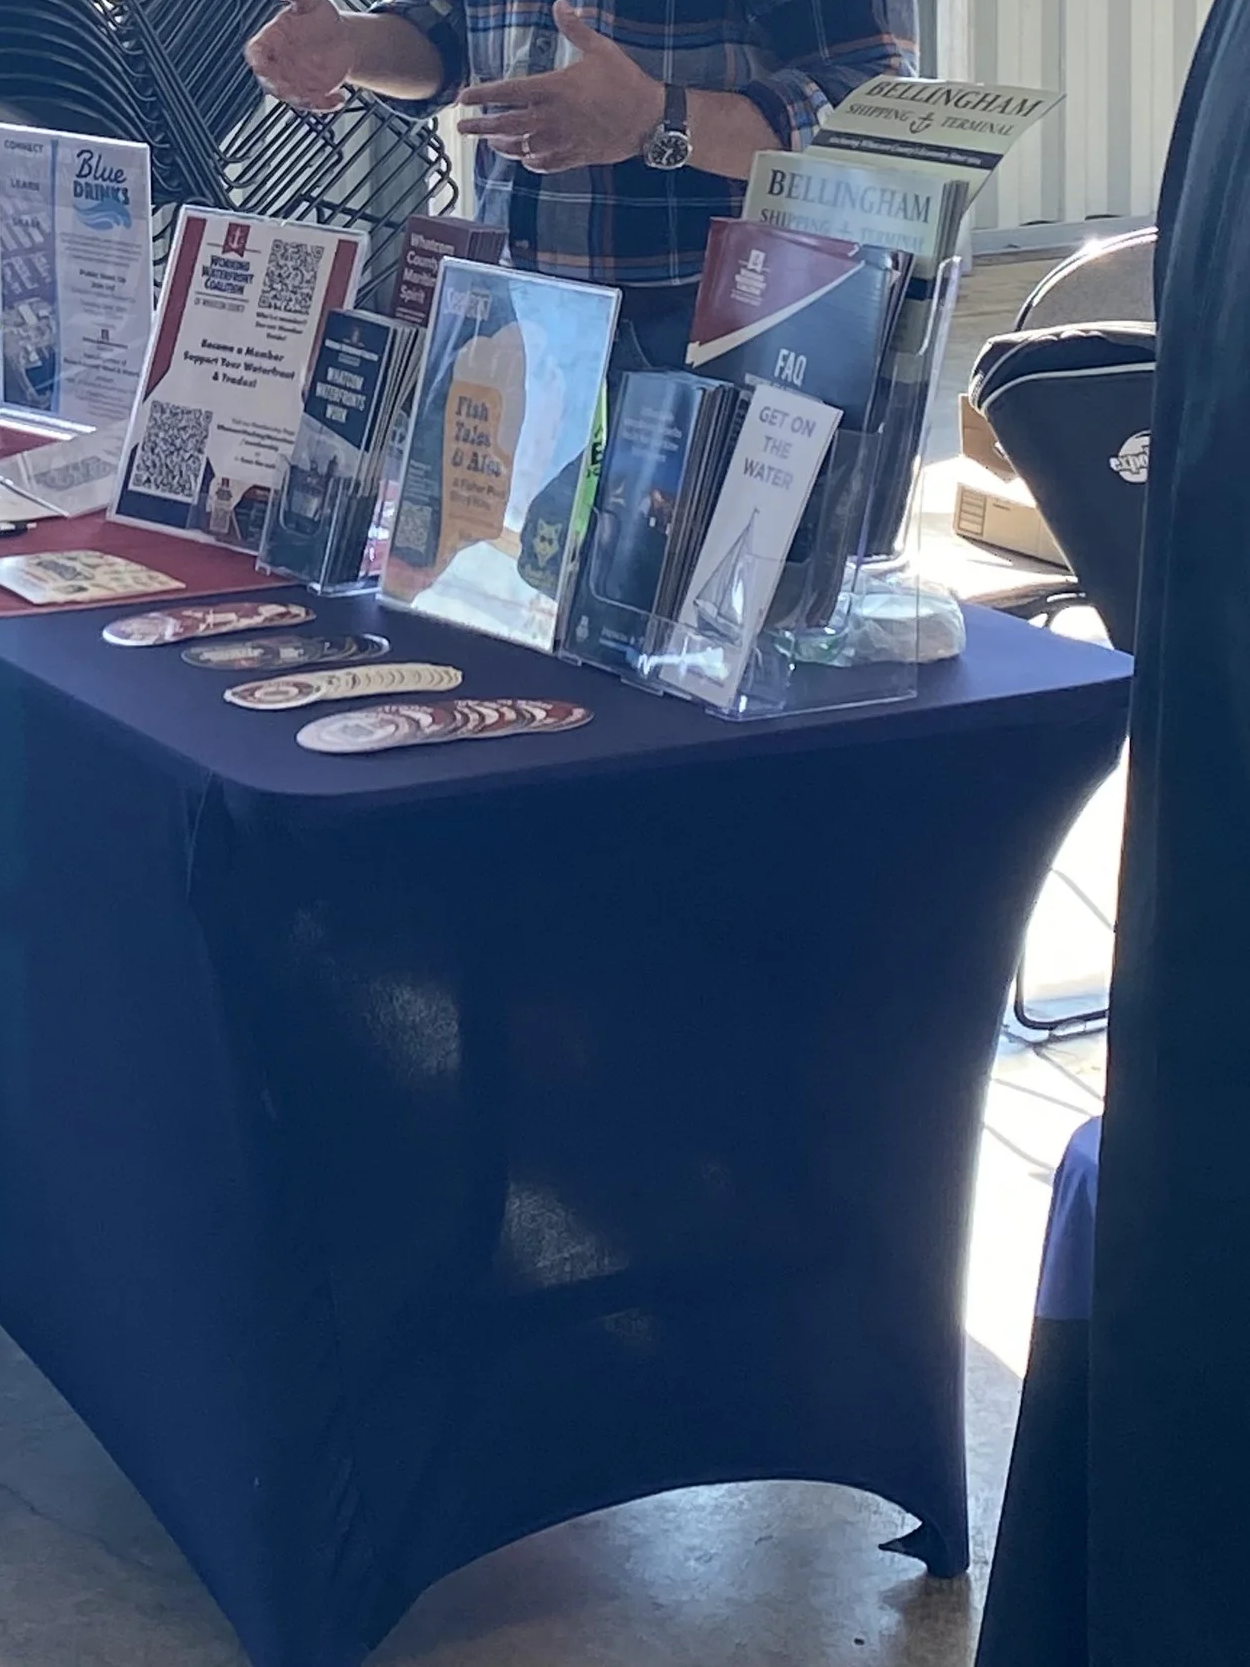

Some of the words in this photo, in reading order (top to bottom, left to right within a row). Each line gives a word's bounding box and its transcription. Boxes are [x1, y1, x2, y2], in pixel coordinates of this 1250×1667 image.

[865, 81, 1043, 118] BELLINGHAM
[847, 103, 910, 122] SHIPPING
[941, 116, 1014, 136] TERMINAL
[4, 139, 44, 153] CONNECT
[75, 148, 127, 184] Blue
[10, 178, 40, 191] LEARN
[73, 180, 130, 205] DRINKS
[767, 169, 933, 223] BELLINGHAM
[759, 207, 831, 234] SHIPPING
[410, 232, 455, 256] Whatcom
[202, 265, 254, 284] WATERFRONT
[211, 255, 250, 271] WORKING
[406, 250, 439, 274] County
[205, 277, 244, 295] COALITION
[399, 284, 425, 304] Spirit
[201, 339, 234, 353] Become
[236, 346, 243, 354] a
[245, 347, 285, 362] Member
[183, 350, 219, 366] Support
[221, 356, 241, 369] Your
[244, 359, 295, 380] Waterfront
[212, 371, 219, 382] &
[774, 348, 807, 387] FAQ
[455, 395, 488, 423] Fish
[454, 420, 492, 449] Tales
[759, 406, 791, 429] GET
[791, 415, 817, 438] ON
[762, 435, 794, 460] THE
[743, 457, 795, 491] WATER
